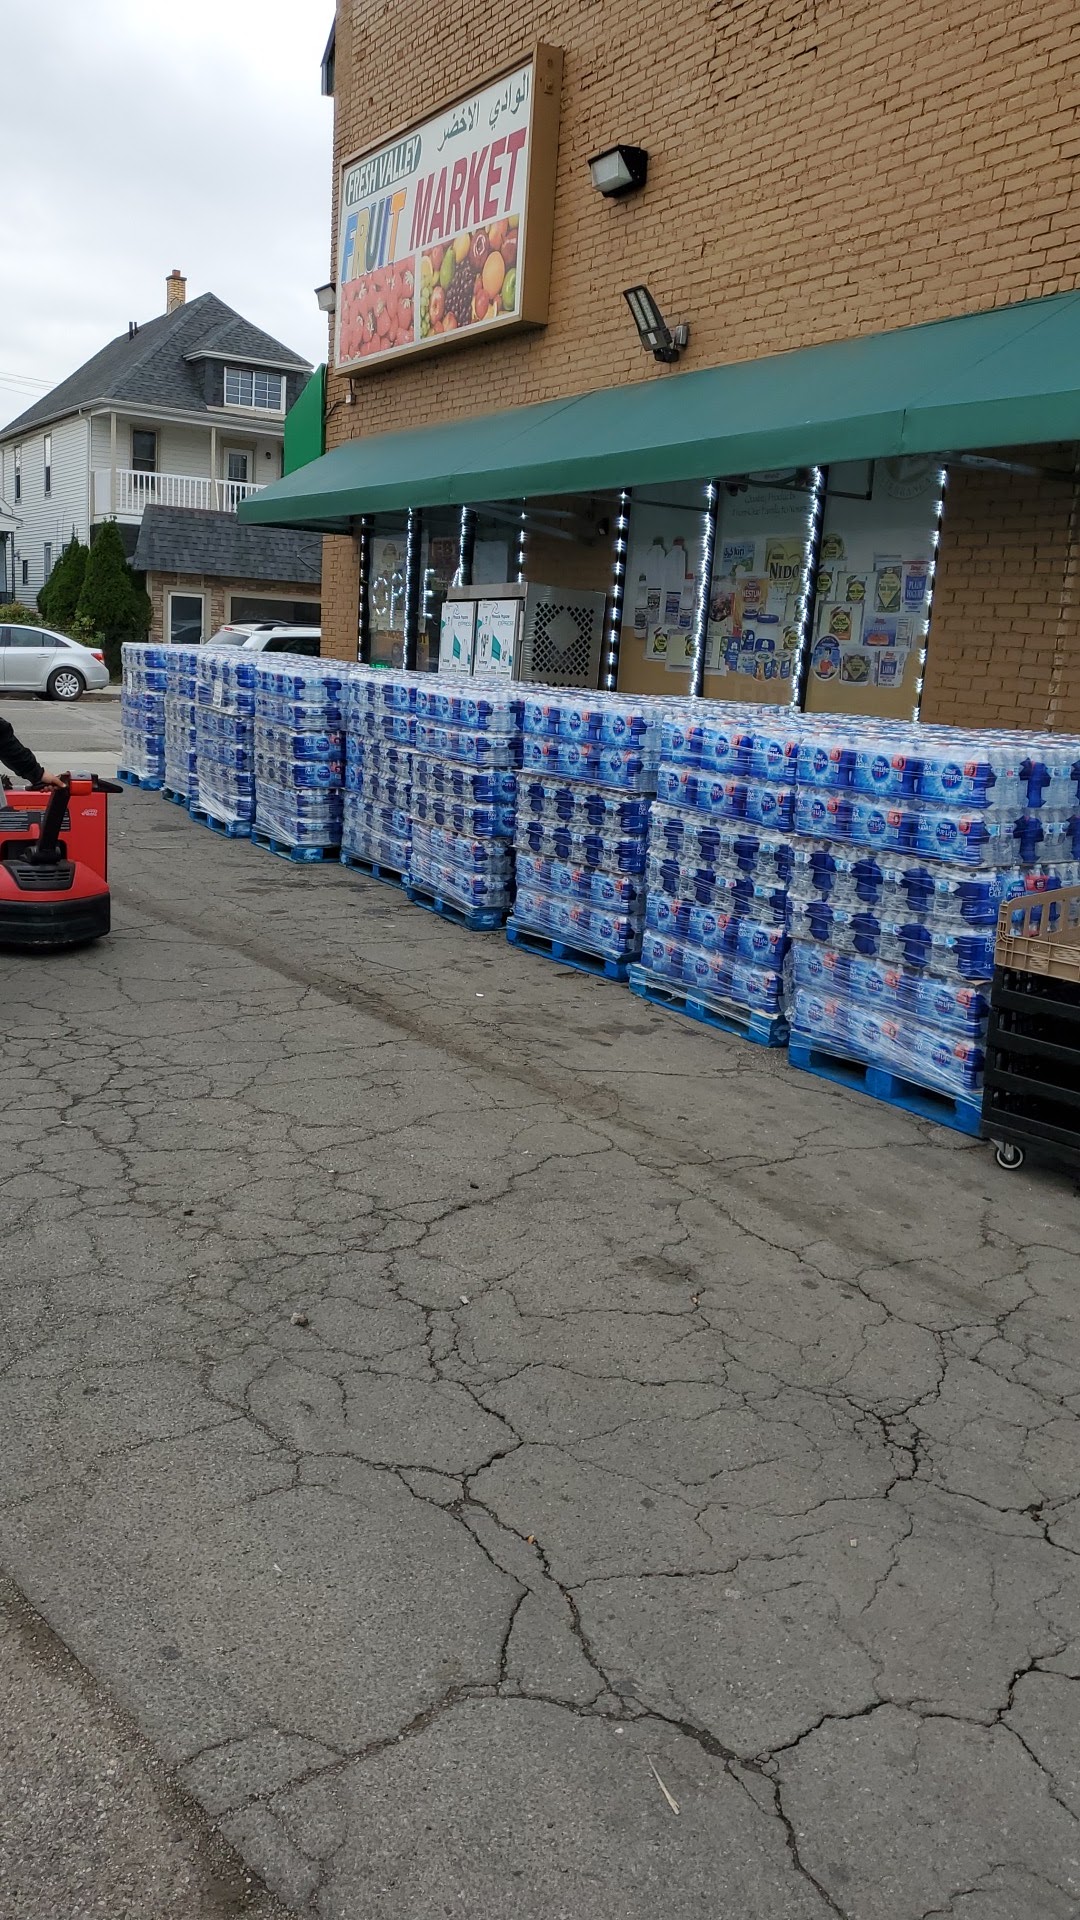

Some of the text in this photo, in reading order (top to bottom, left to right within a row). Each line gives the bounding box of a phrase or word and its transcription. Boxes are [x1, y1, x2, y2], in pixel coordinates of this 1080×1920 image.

[489, 72, 530, 131] الوادي
[347, 135, 420, 206] FRESH VALLEY
[341, 127, 527, 285] FRUIT MARKET
[769, 562, 801, 580] NIDO
